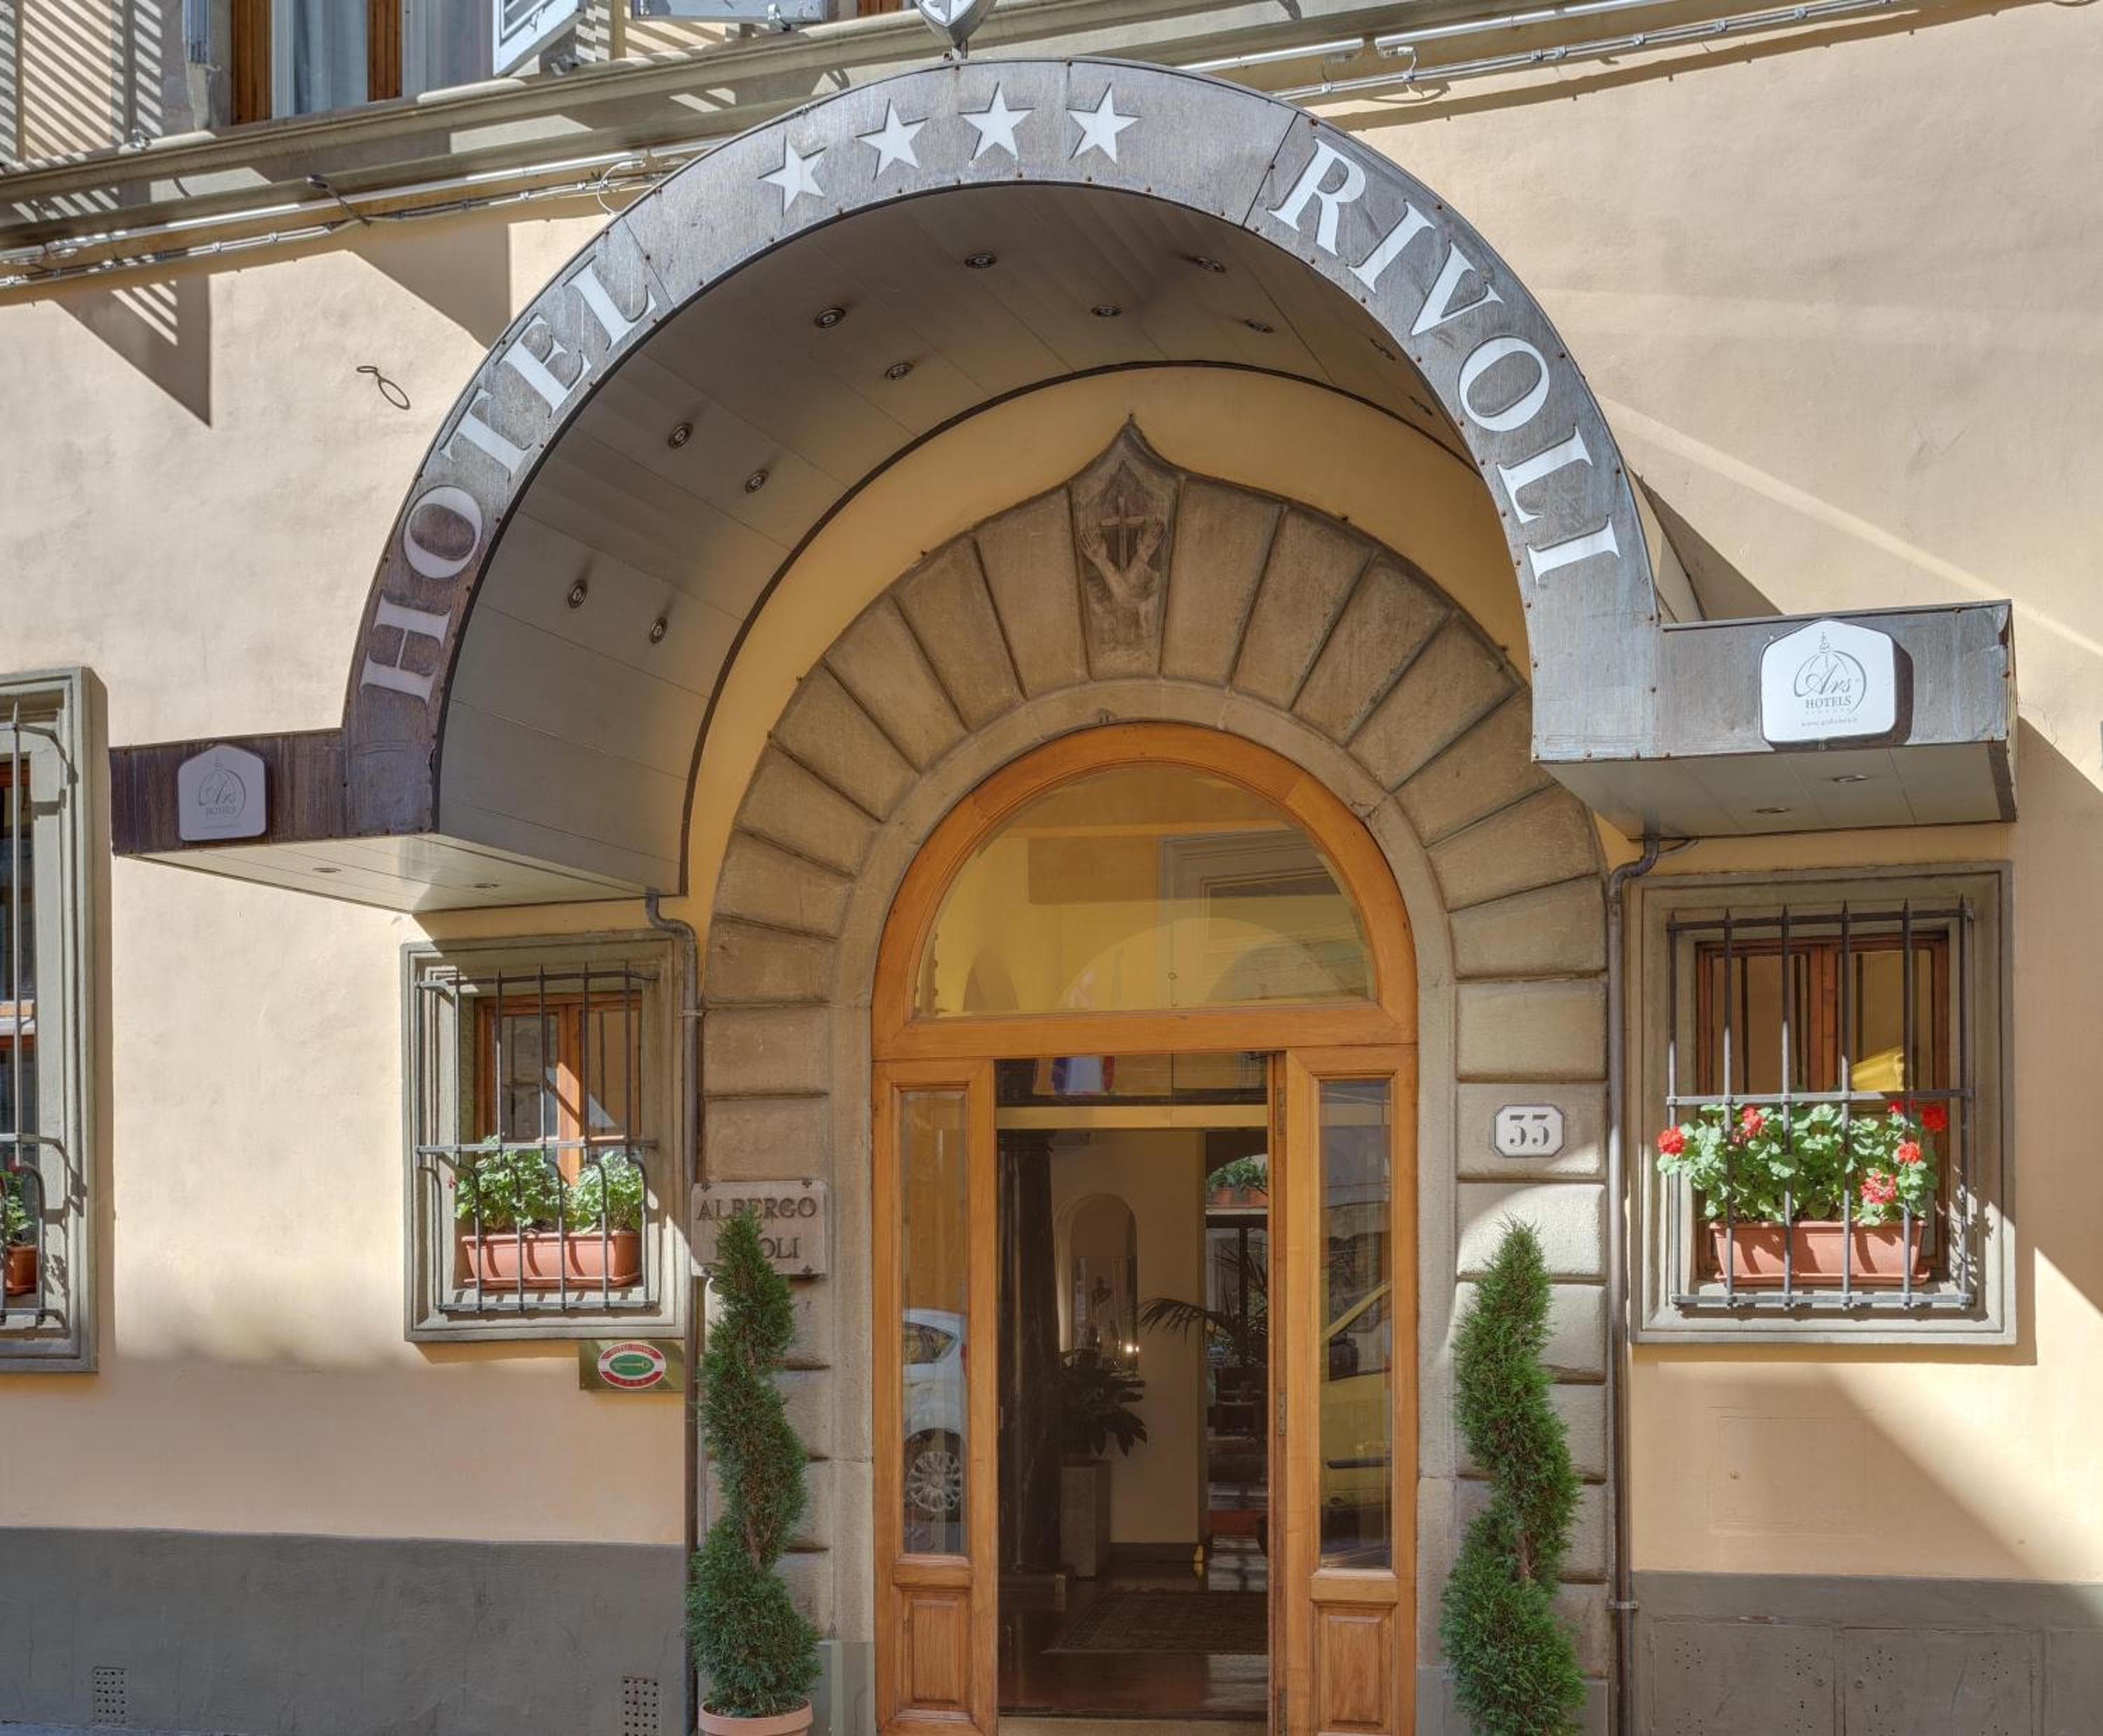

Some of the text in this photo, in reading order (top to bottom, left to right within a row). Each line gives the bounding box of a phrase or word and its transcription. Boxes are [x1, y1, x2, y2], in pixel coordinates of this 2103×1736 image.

[360, 137, 1620, 705] HOTEL RIVOLI
[1794, 663, 1851, 697] Ars
[1805, 695, 1851, 709] HOTELS
[1509, 1114, 1550, 1146] 55
[695, 1196, 817, 1221] ALBERGO
